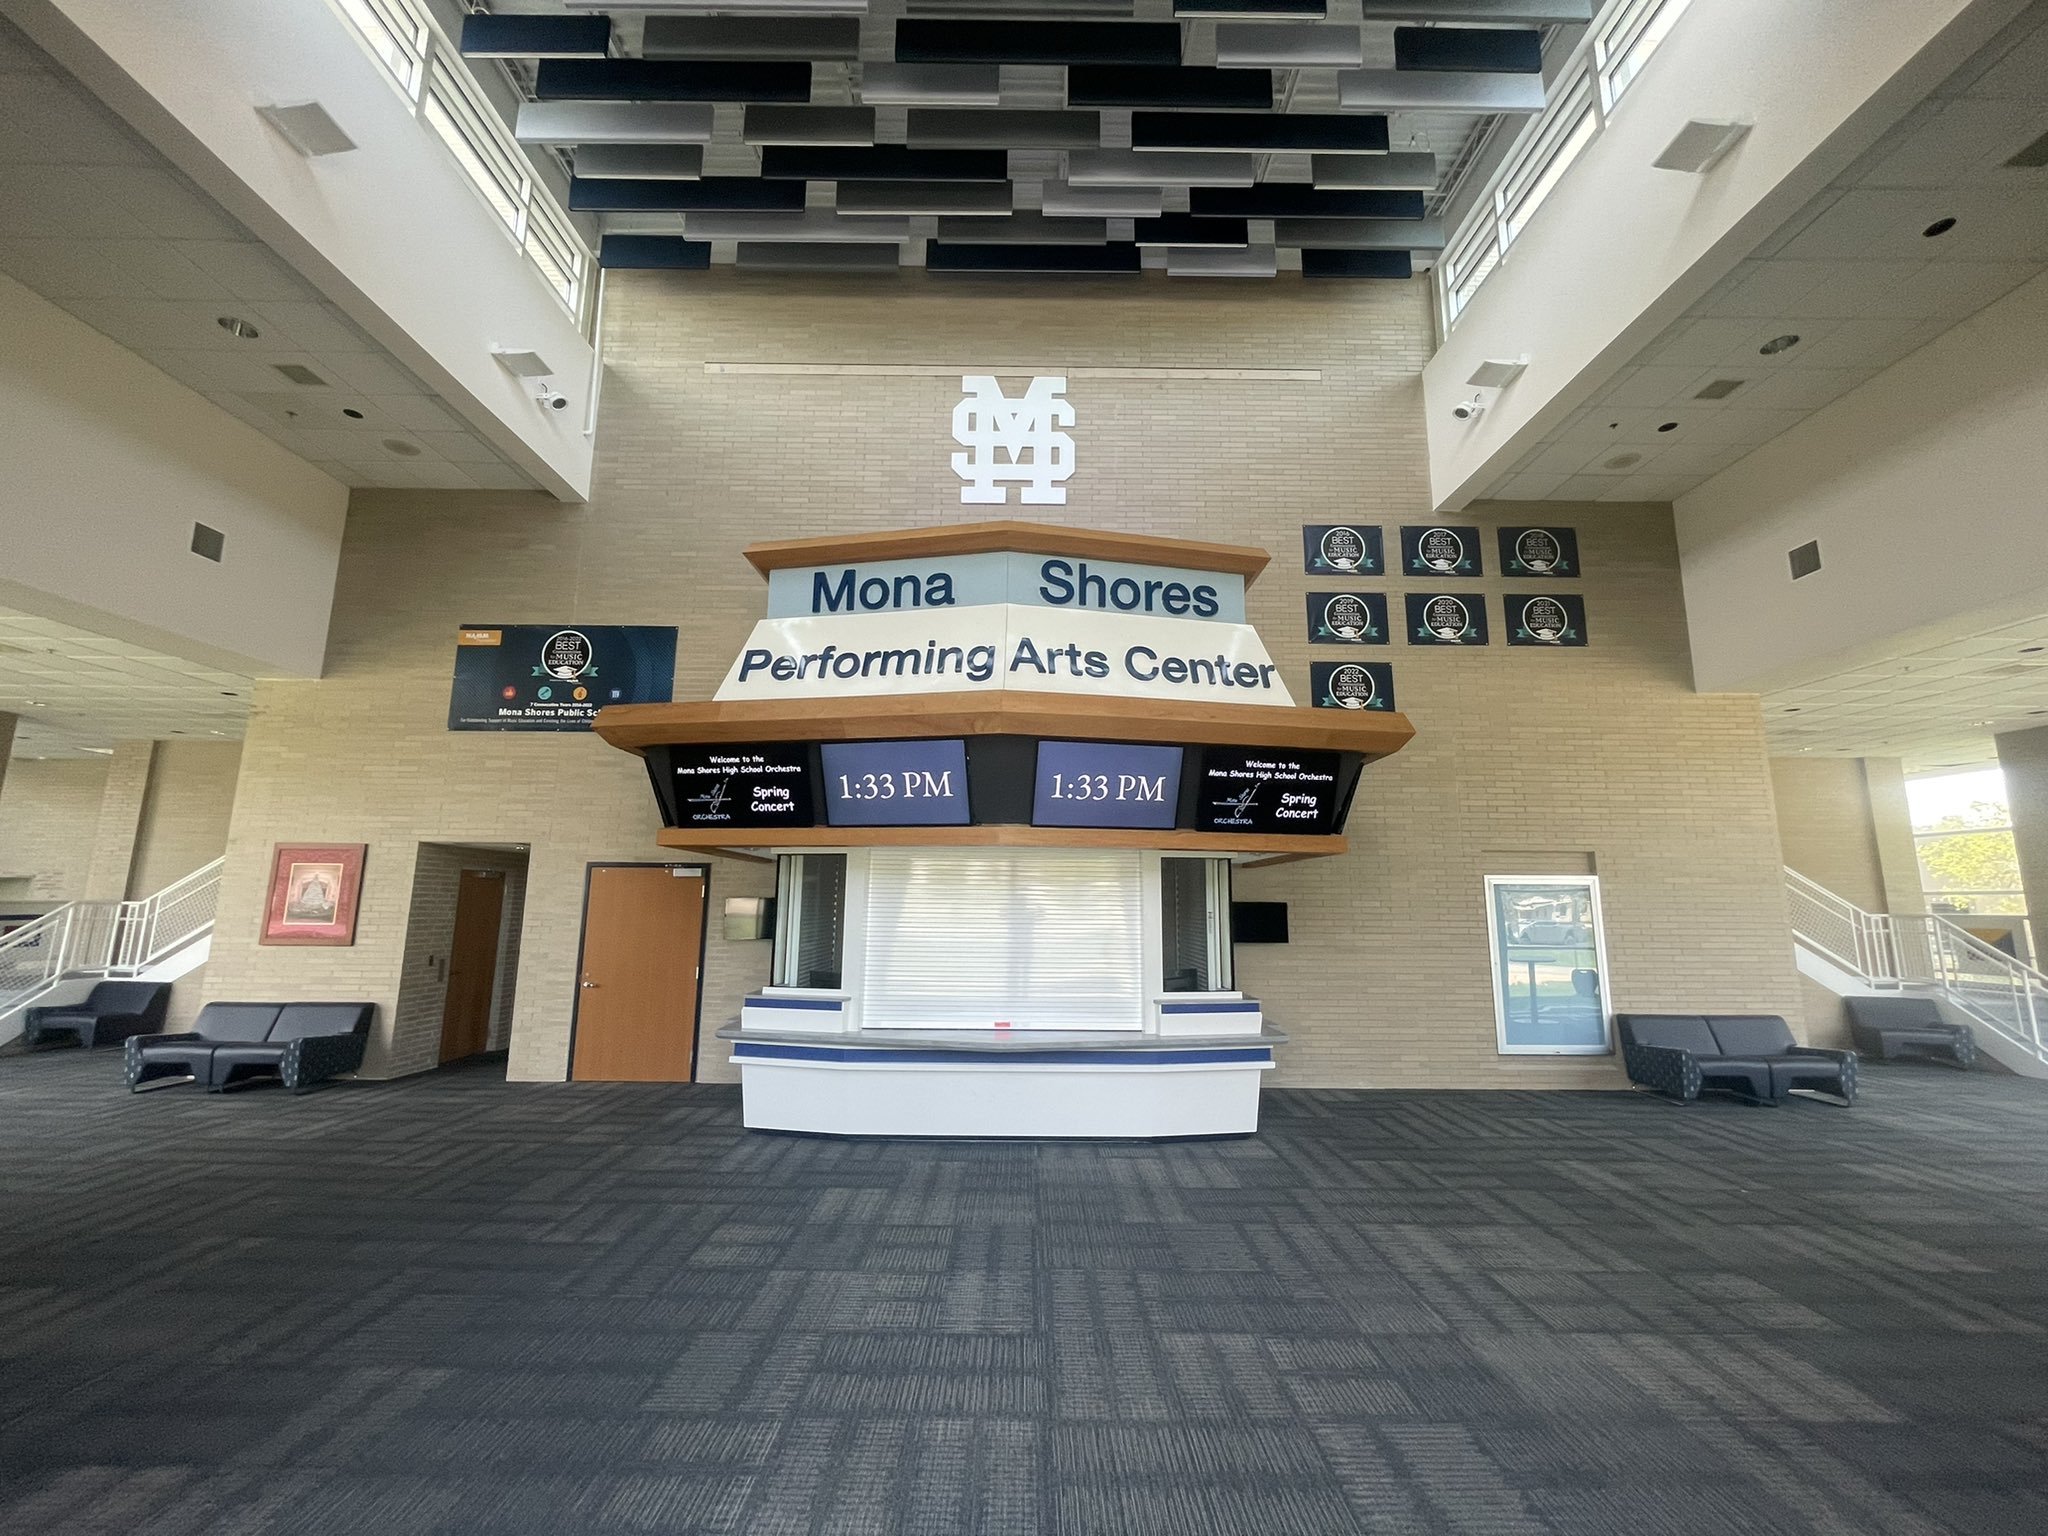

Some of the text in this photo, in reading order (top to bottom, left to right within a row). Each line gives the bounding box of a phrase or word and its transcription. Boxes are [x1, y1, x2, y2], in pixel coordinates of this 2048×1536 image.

[1429, 537, 1452, 545] BEST
[812, 560, 1219, 617] Mona Shores
[1335, 604, 1358, 612] BEST
[1434, 605, 1457, 613] BEST
[1533, 606, 1555, 614] BEST
[555, 640, 581, 650] BEST
[555, 653, 583, 661] MUSIC
[738, 637, 1276, 689] Performing Arts Center
[1340, 674, 1363, 682] BEST
[498, 708, 522, 716] Mona
[525, 708, 555, 717] Shores
[557, 708, 585, 717] Public
[709, 756, 740, 764] Welcome
[752, 755, 764, 763] the
[1245, 760, 1276, 769] Welcome
[1288, 762, 1300, 770] the
[696, 766, 721, 774] Shores
[722, 766, 739, 776] High
[740, 765, 763, 773] School
[765, 765, 801, 773] Orchestra
[1208, 769, 1333, 781] Mona Shores High School Orchestra
[839, 771, 954, 800] 1:33 PM
[1050, 773, 1166, 802] 1:33 PM
[753, 786, 790, 800] Spring
[1280, 793, 1317, 807] Spring
[750, 801, 795, 812] Concert
[1275, 807, 1319, 819] Concert
